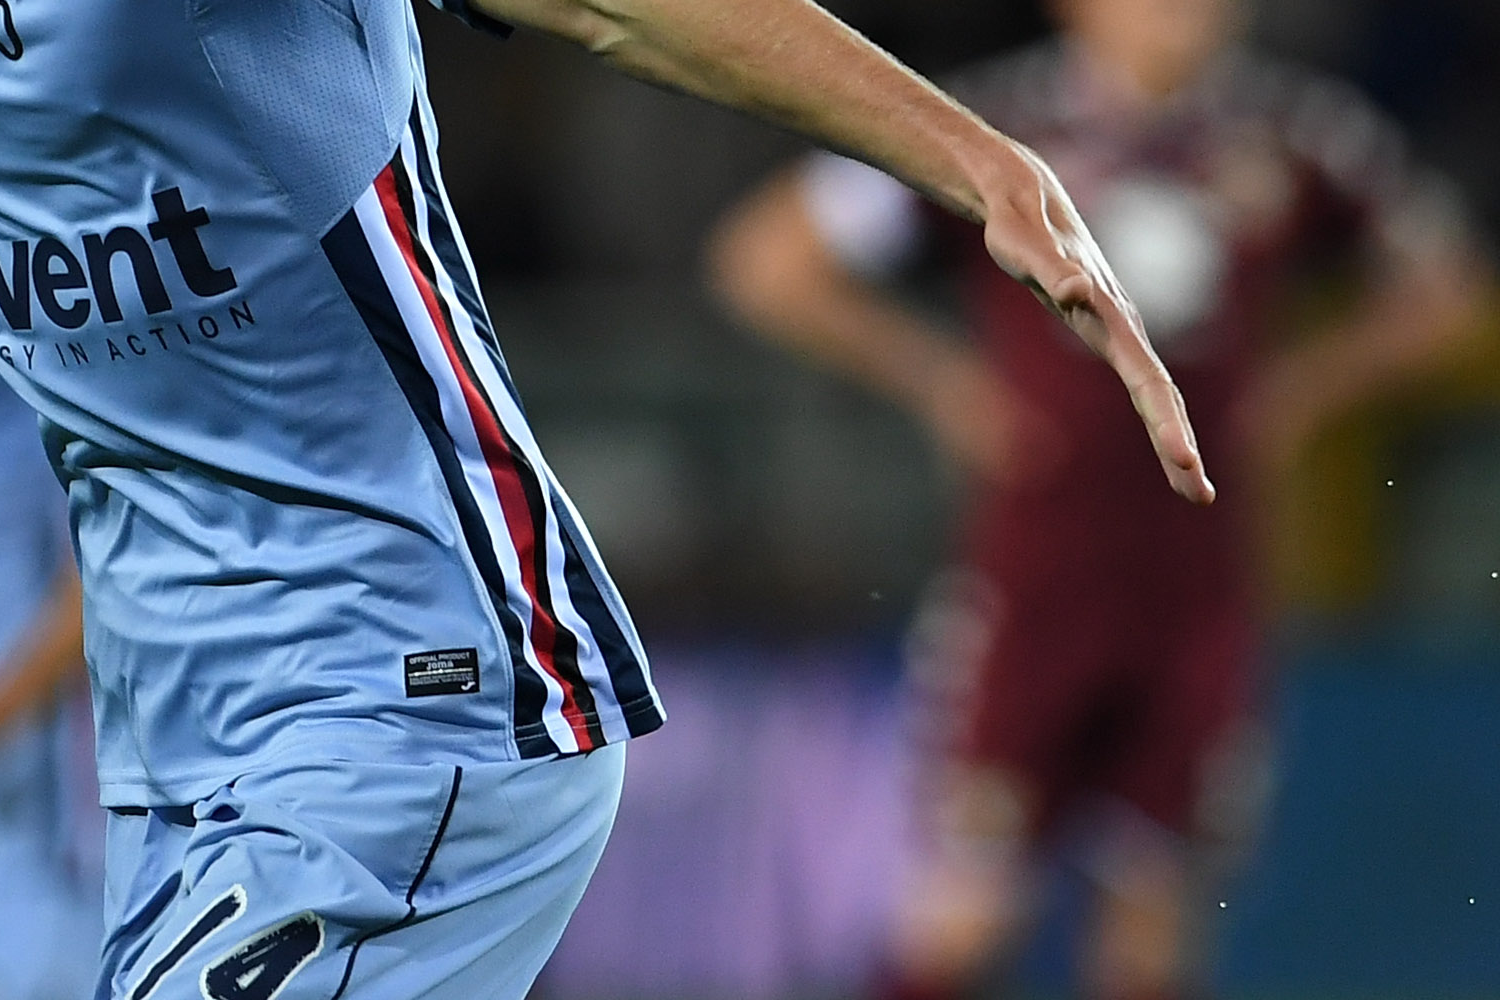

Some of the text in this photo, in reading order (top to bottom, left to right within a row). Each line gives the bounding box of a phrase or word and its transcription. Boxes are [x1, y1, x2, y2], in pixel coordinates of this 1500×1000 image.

[0, 301, 256, 370] GY IN ACTION
